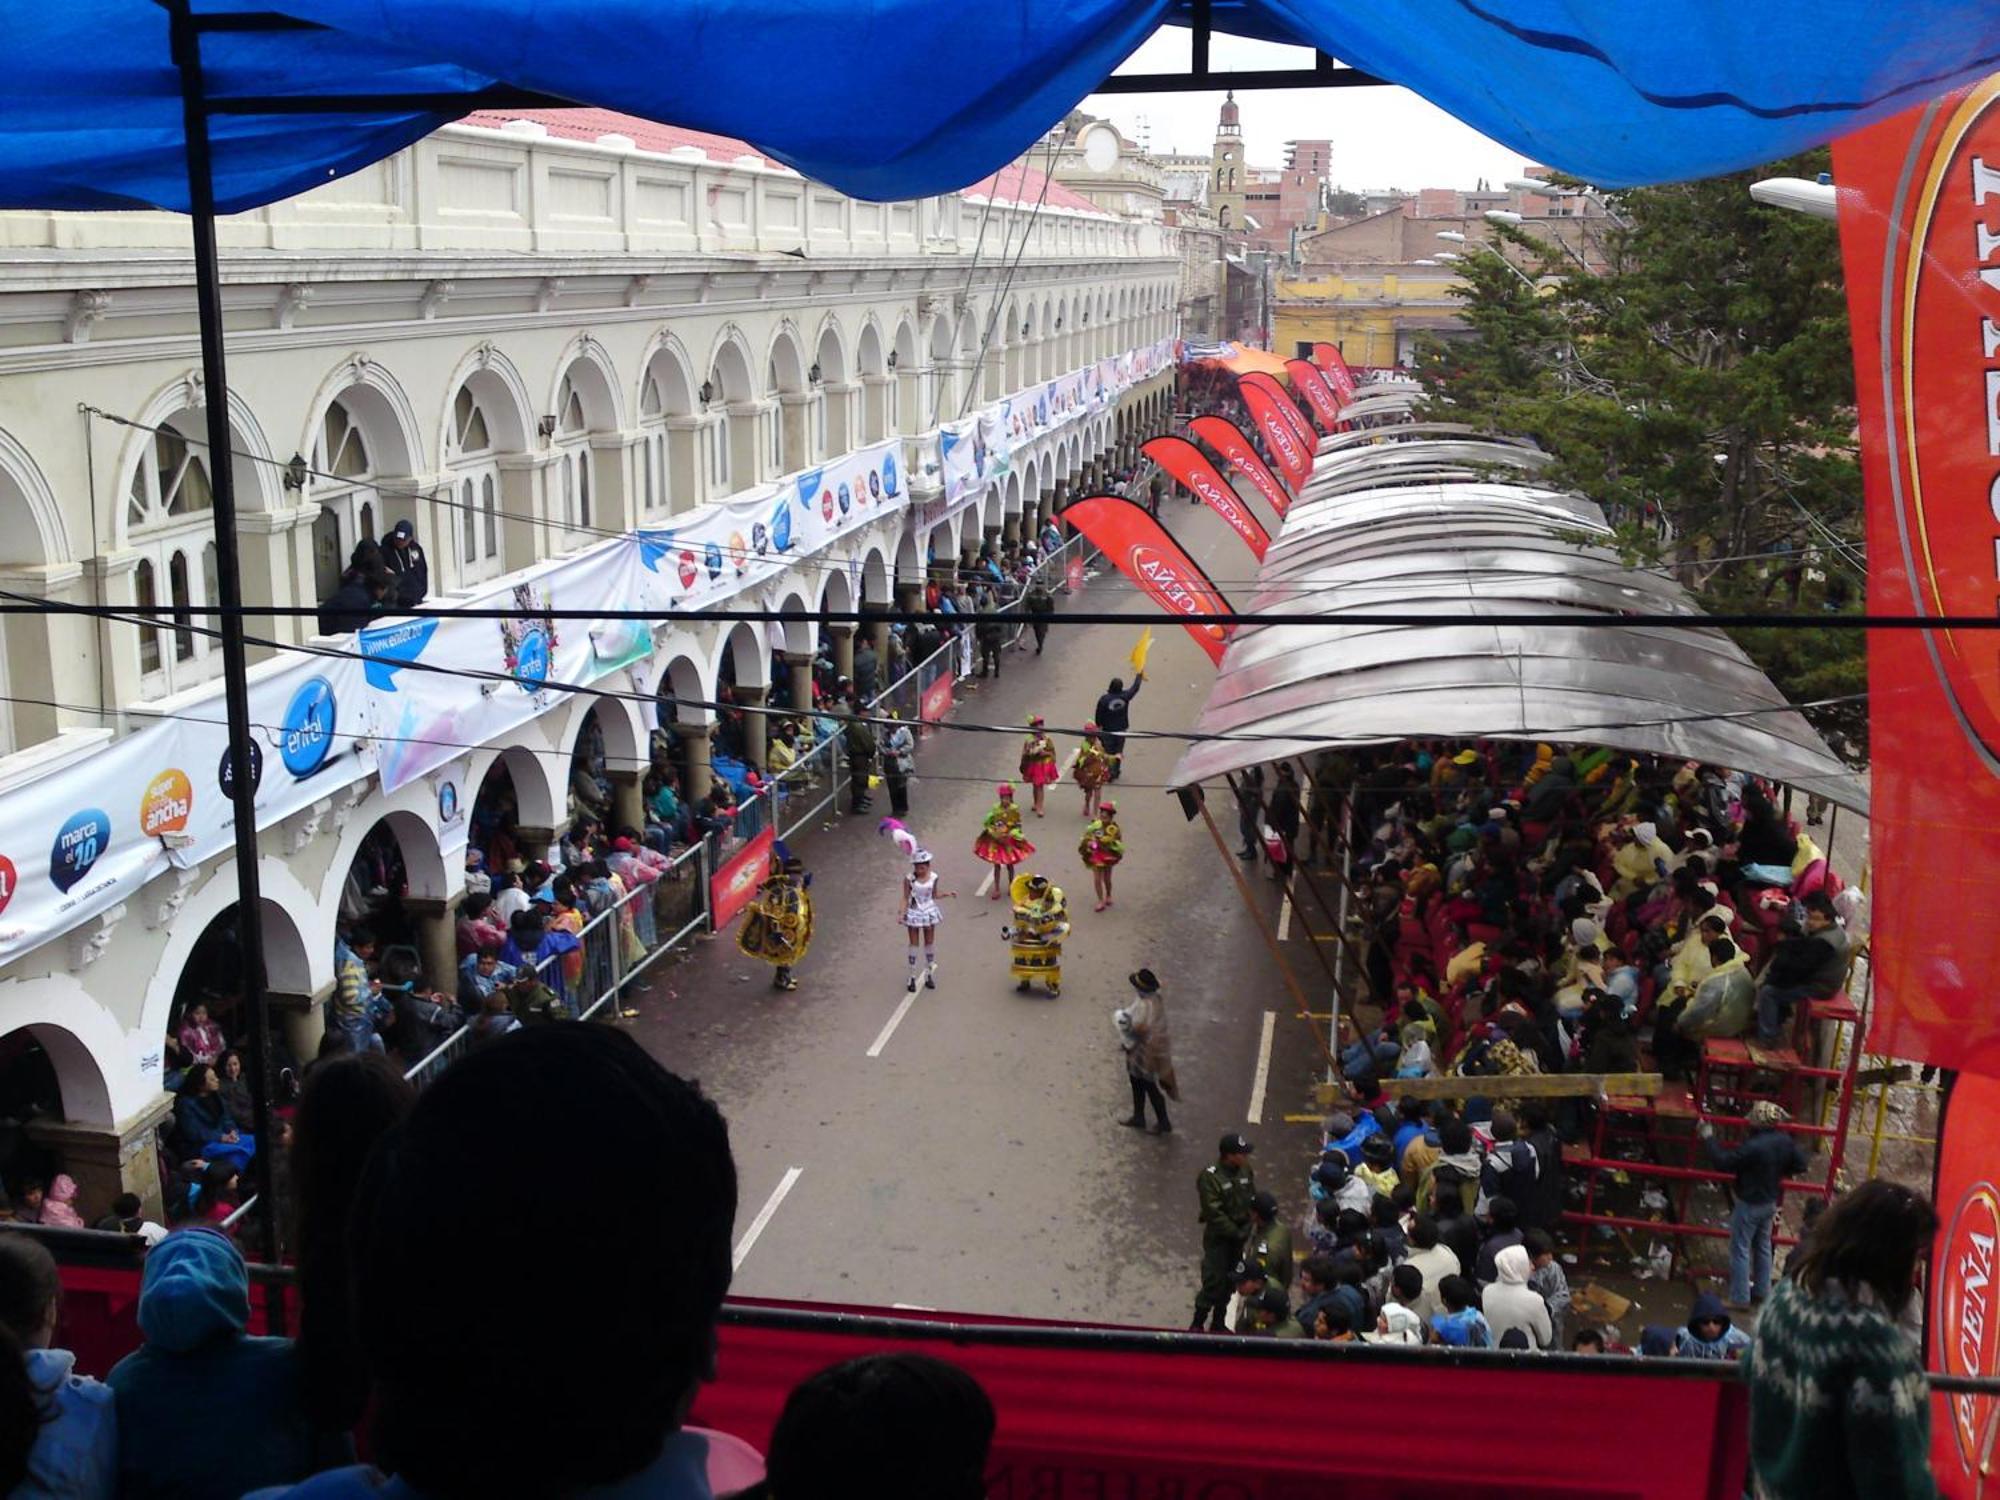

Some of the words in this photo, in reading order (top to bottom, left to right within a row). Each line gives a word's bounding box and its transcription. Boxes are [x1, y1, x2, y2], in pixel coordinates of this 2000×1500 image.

[287, 713, 323, 754] entel
[146, 797, 188, 831] ancha
[61, 821, 98, 850] marca
[65, 848, 75, 864] el
[74, 837, 98, 871] 10
